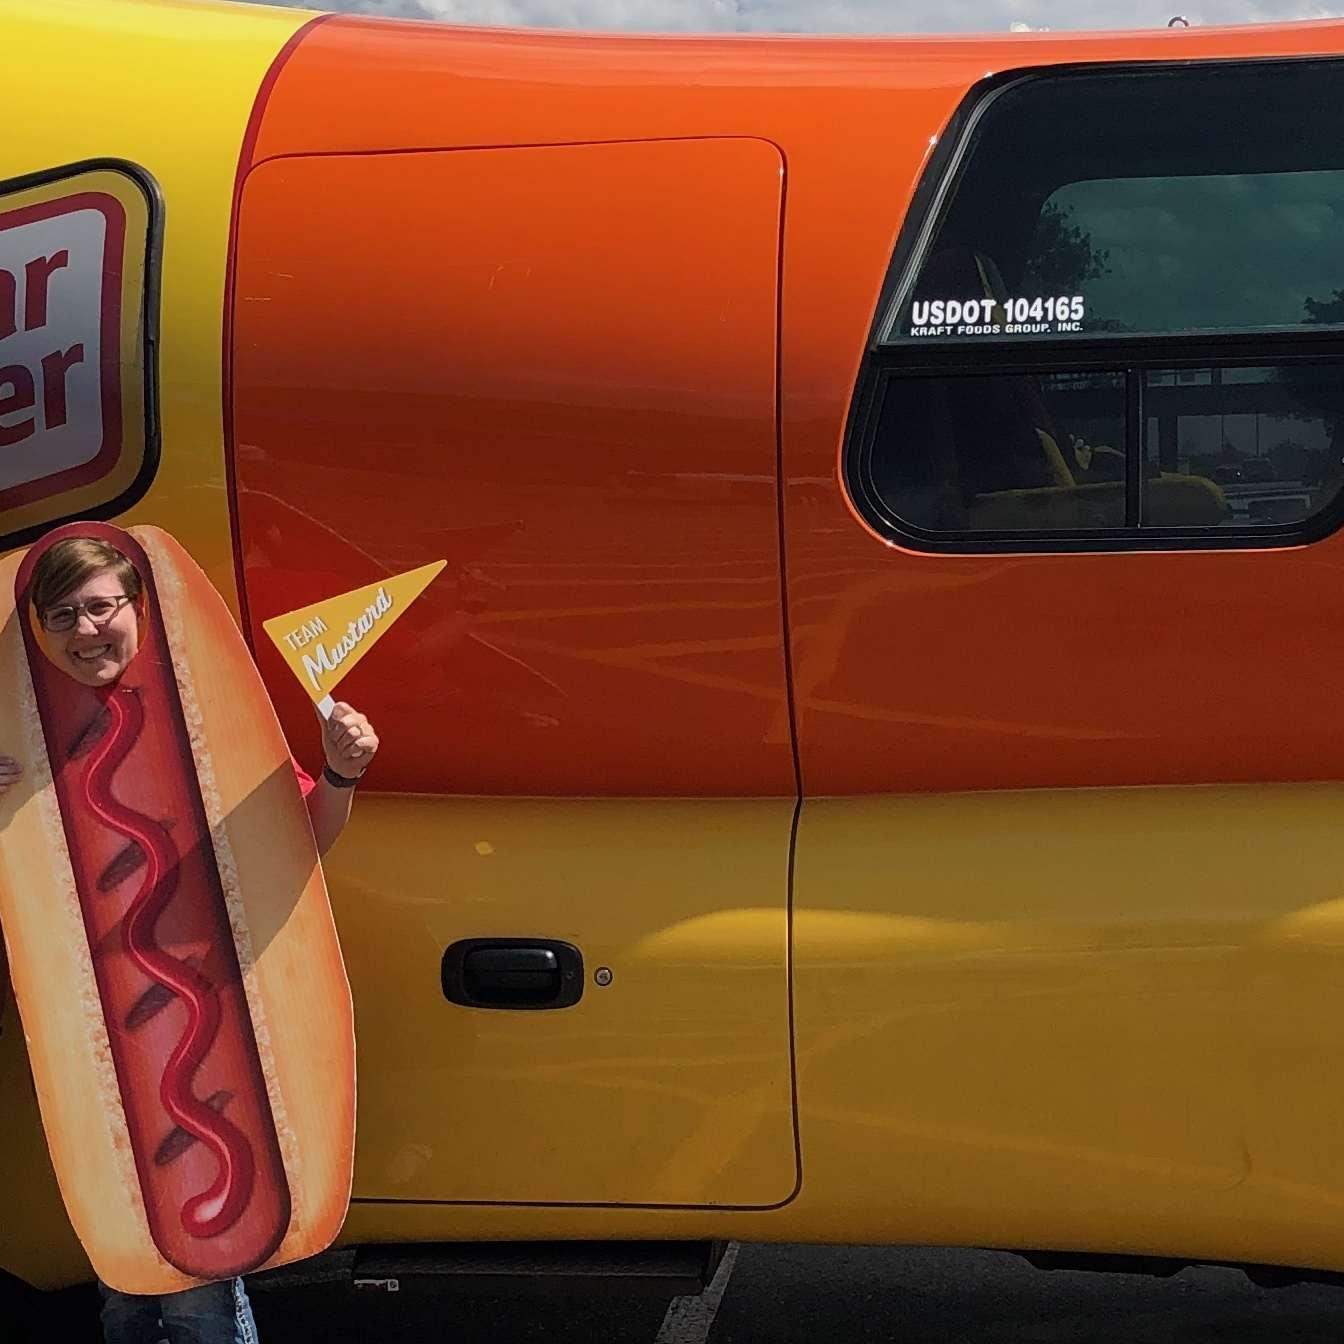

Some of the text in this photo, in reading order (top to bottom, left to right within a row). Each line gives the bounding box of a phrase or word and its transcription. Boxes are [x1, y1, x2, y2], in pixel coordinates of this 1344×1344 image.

[912, 296, 1085, 326] USDOT 104165
[910, 325, 953, 337] KRAFT
[957, 324, 1000, 335] FOODS
[1057, 322, 1084, 332] INC.
[282, 615, 329, 651] TEAM
[301, 586, 393, 692] Mustard
